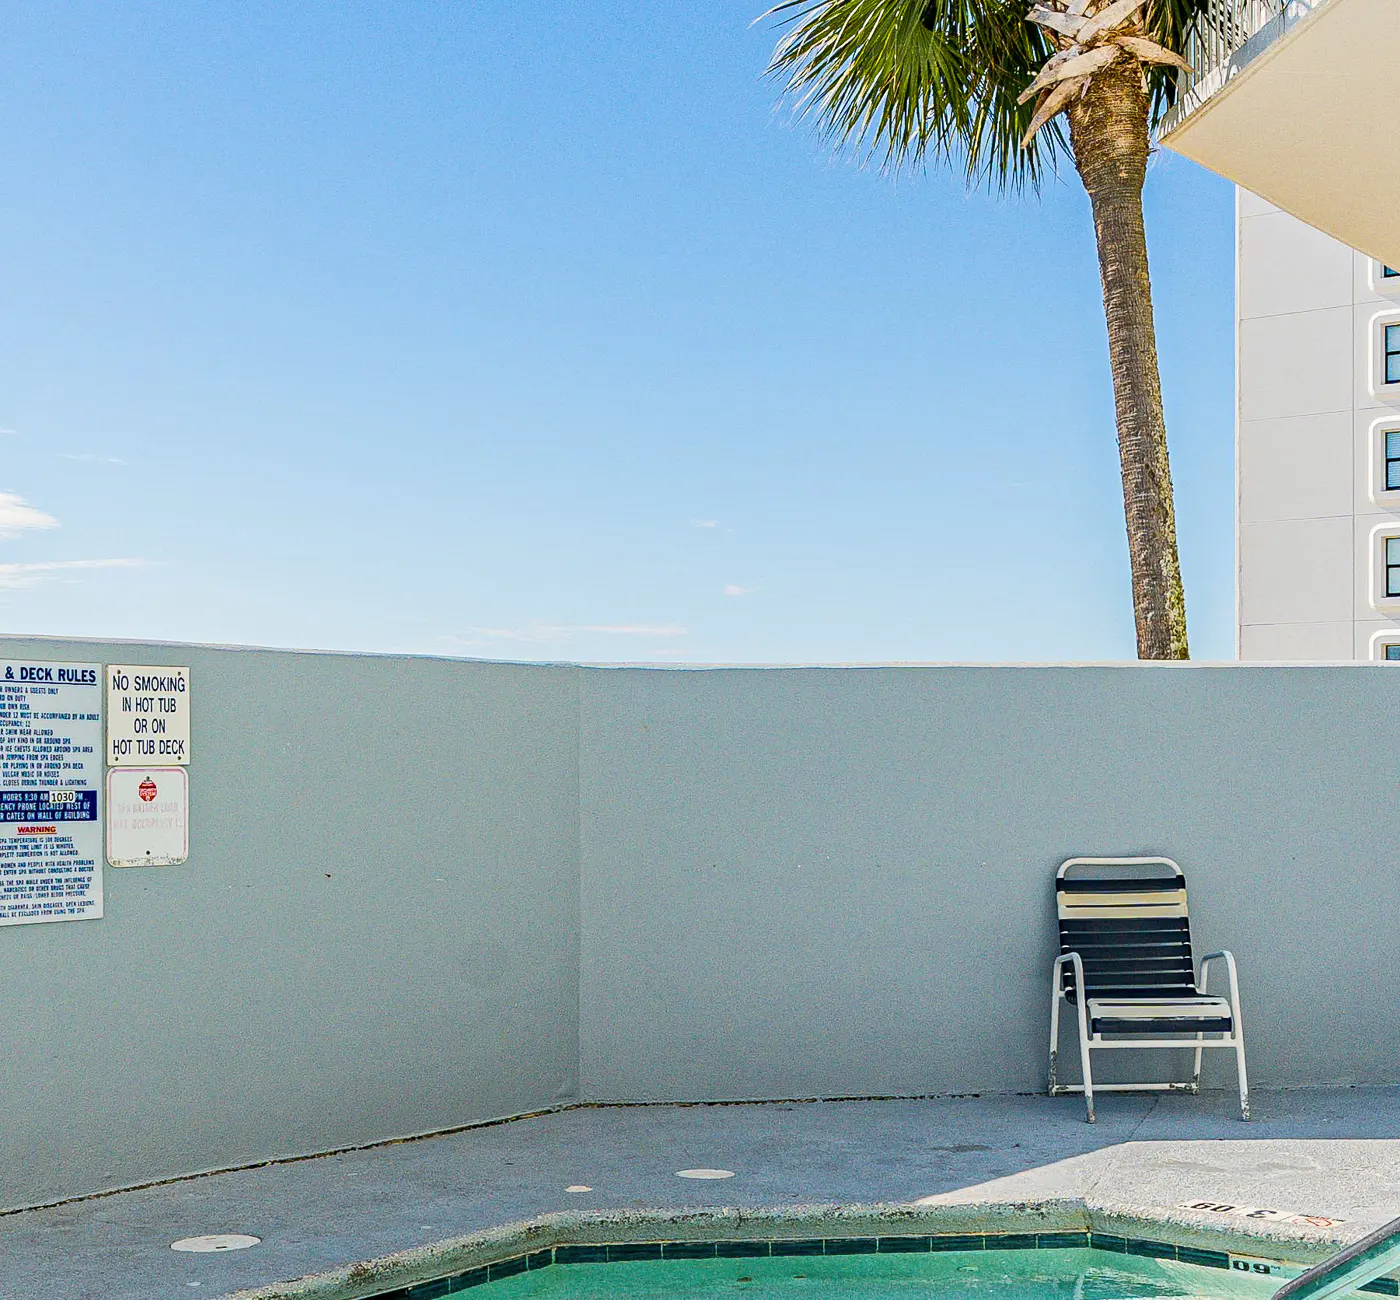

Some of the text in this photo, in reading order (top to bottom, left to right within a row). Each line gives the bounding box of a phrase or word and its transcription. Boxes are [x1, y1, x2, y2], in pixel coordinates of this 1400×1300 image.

[5, 666, 96, 682] & DECK RULES
[113, 676, 185, 692] NO SMOKING
[123, 697, 176, 712] IN HOT TUB
[134, 718, 165, 733] OR ON
[113, 739, 184, 754] HOT TUB DECK
[3, 793, 22, 801] HOURS
[52, 792, 74, 802] 1030
[66, 802, 80, 810] WEST
